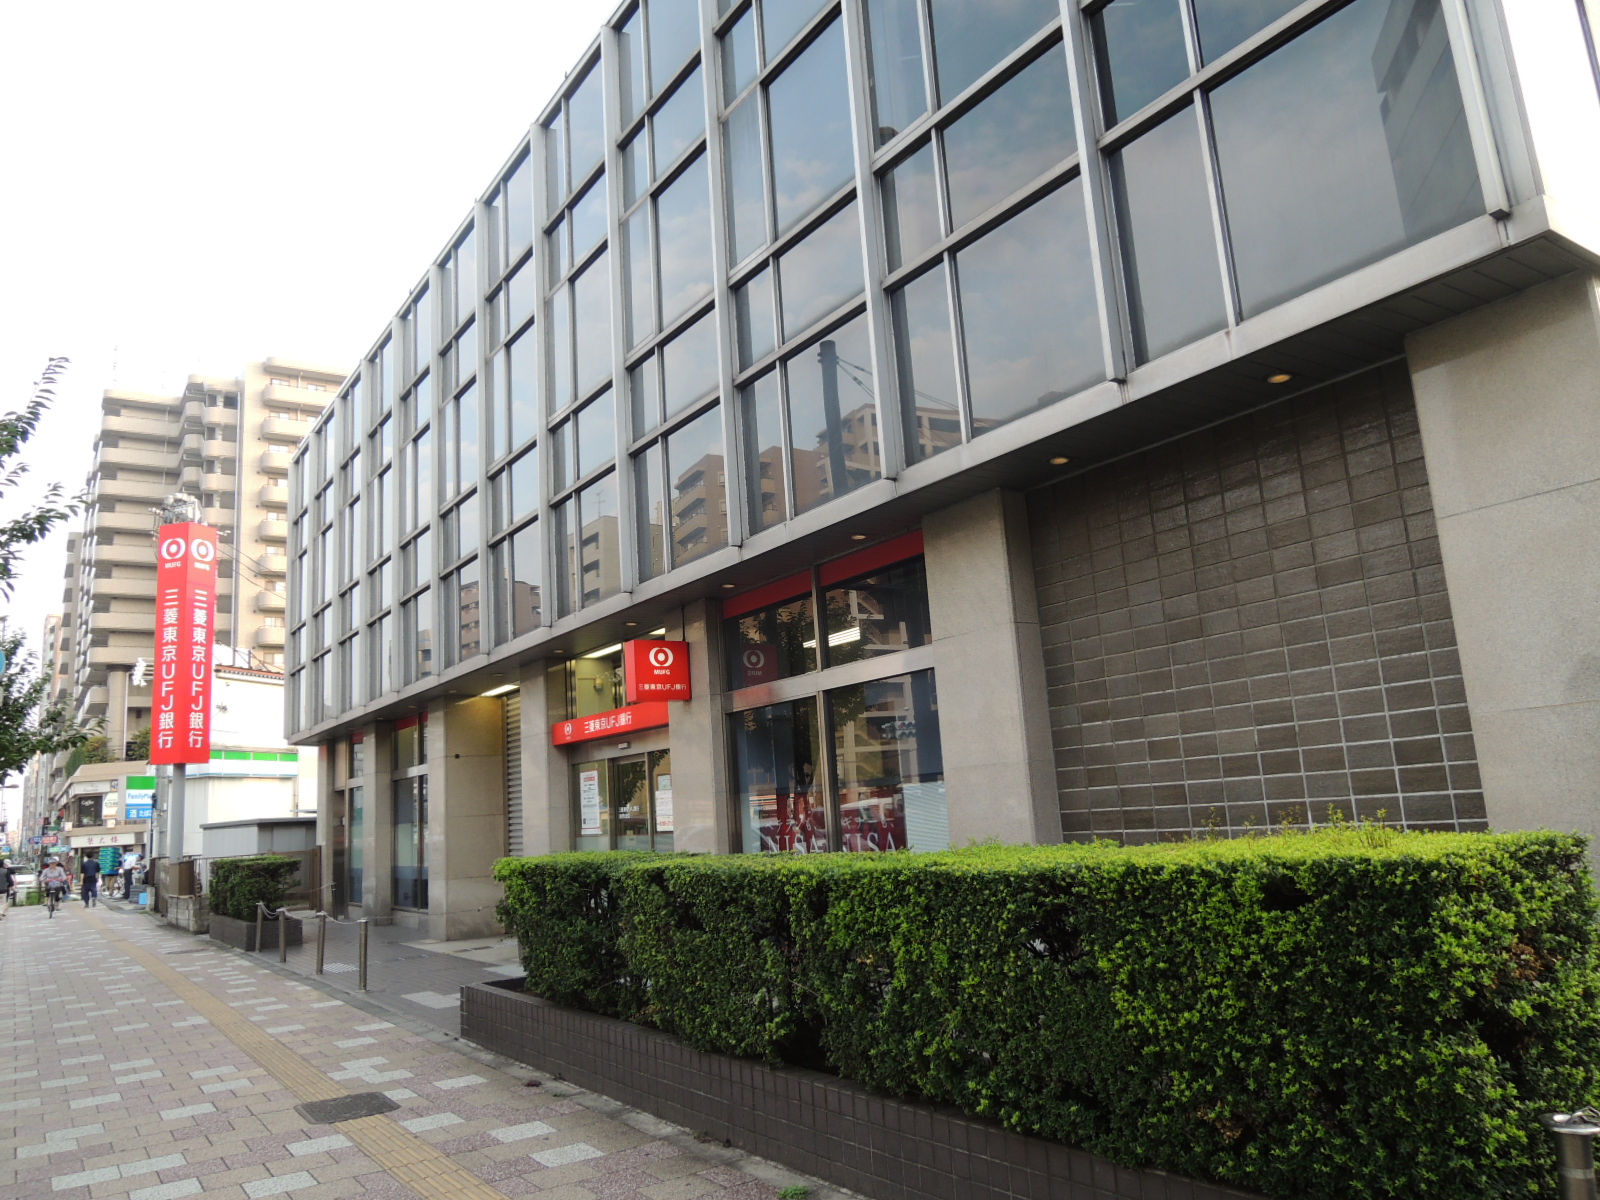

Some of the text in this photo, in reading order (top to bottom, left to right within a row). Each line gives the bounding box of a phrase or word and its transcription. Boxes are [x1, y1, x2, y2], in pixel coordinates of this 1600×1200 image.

[165, 561, 181, 569] MUFG
[158, 588, 178, 748] 三菱東京UFJ銀行
[188, 588, 208, 748] 三菱東京UFJ銀行
[638, 683, 687, 691] 三菱東京UFJ銀行
[583, 711, 632, 734] 三菱東京UFJ銀行
[766, 833, 824, 854] NISA
